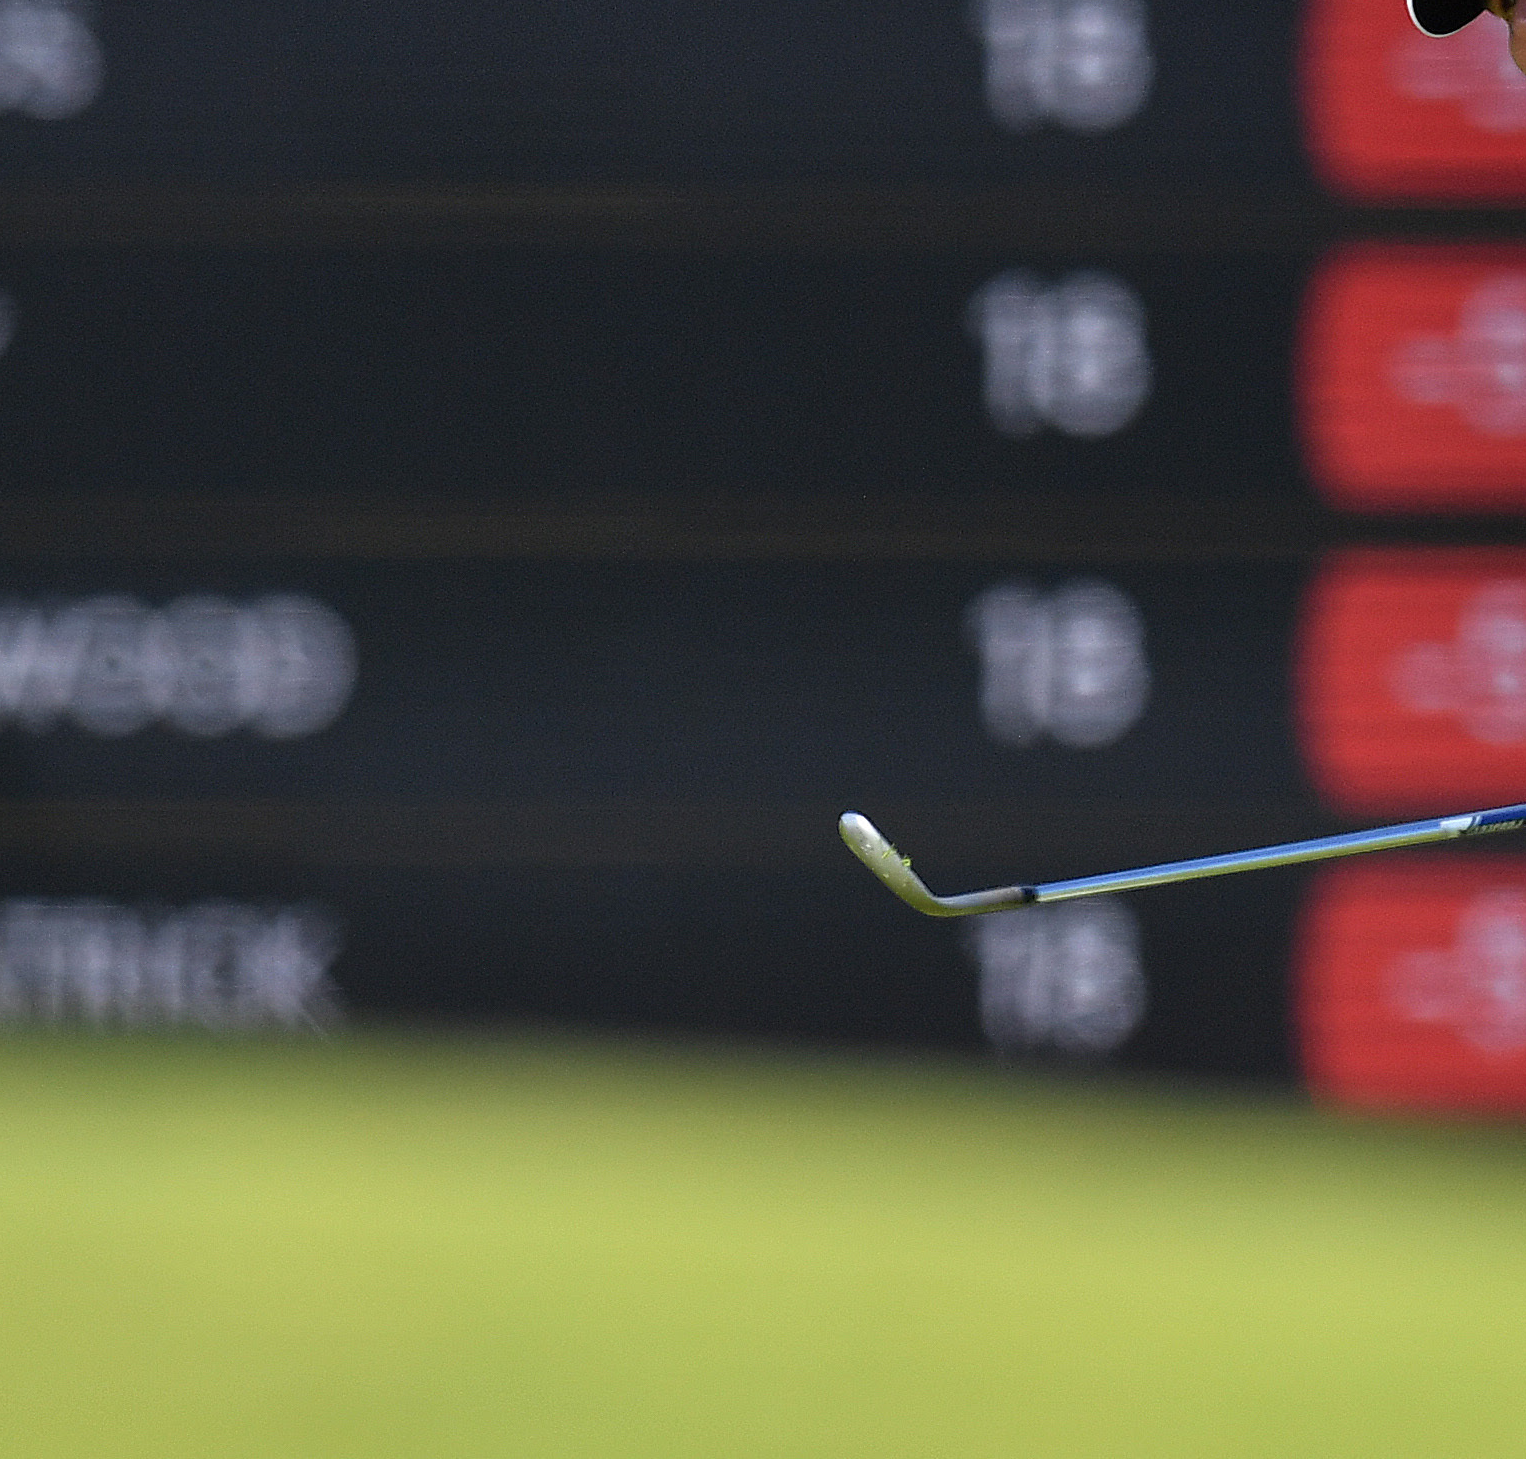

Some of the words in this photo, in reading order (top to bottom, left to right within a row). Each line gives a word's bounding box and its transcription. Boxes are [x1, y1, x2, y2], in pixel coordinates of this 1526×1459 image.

[977, 274, 1151, 438] 18
[975, 583, 1150, 750] 18
[975, 895, 1147, 1057] 18
